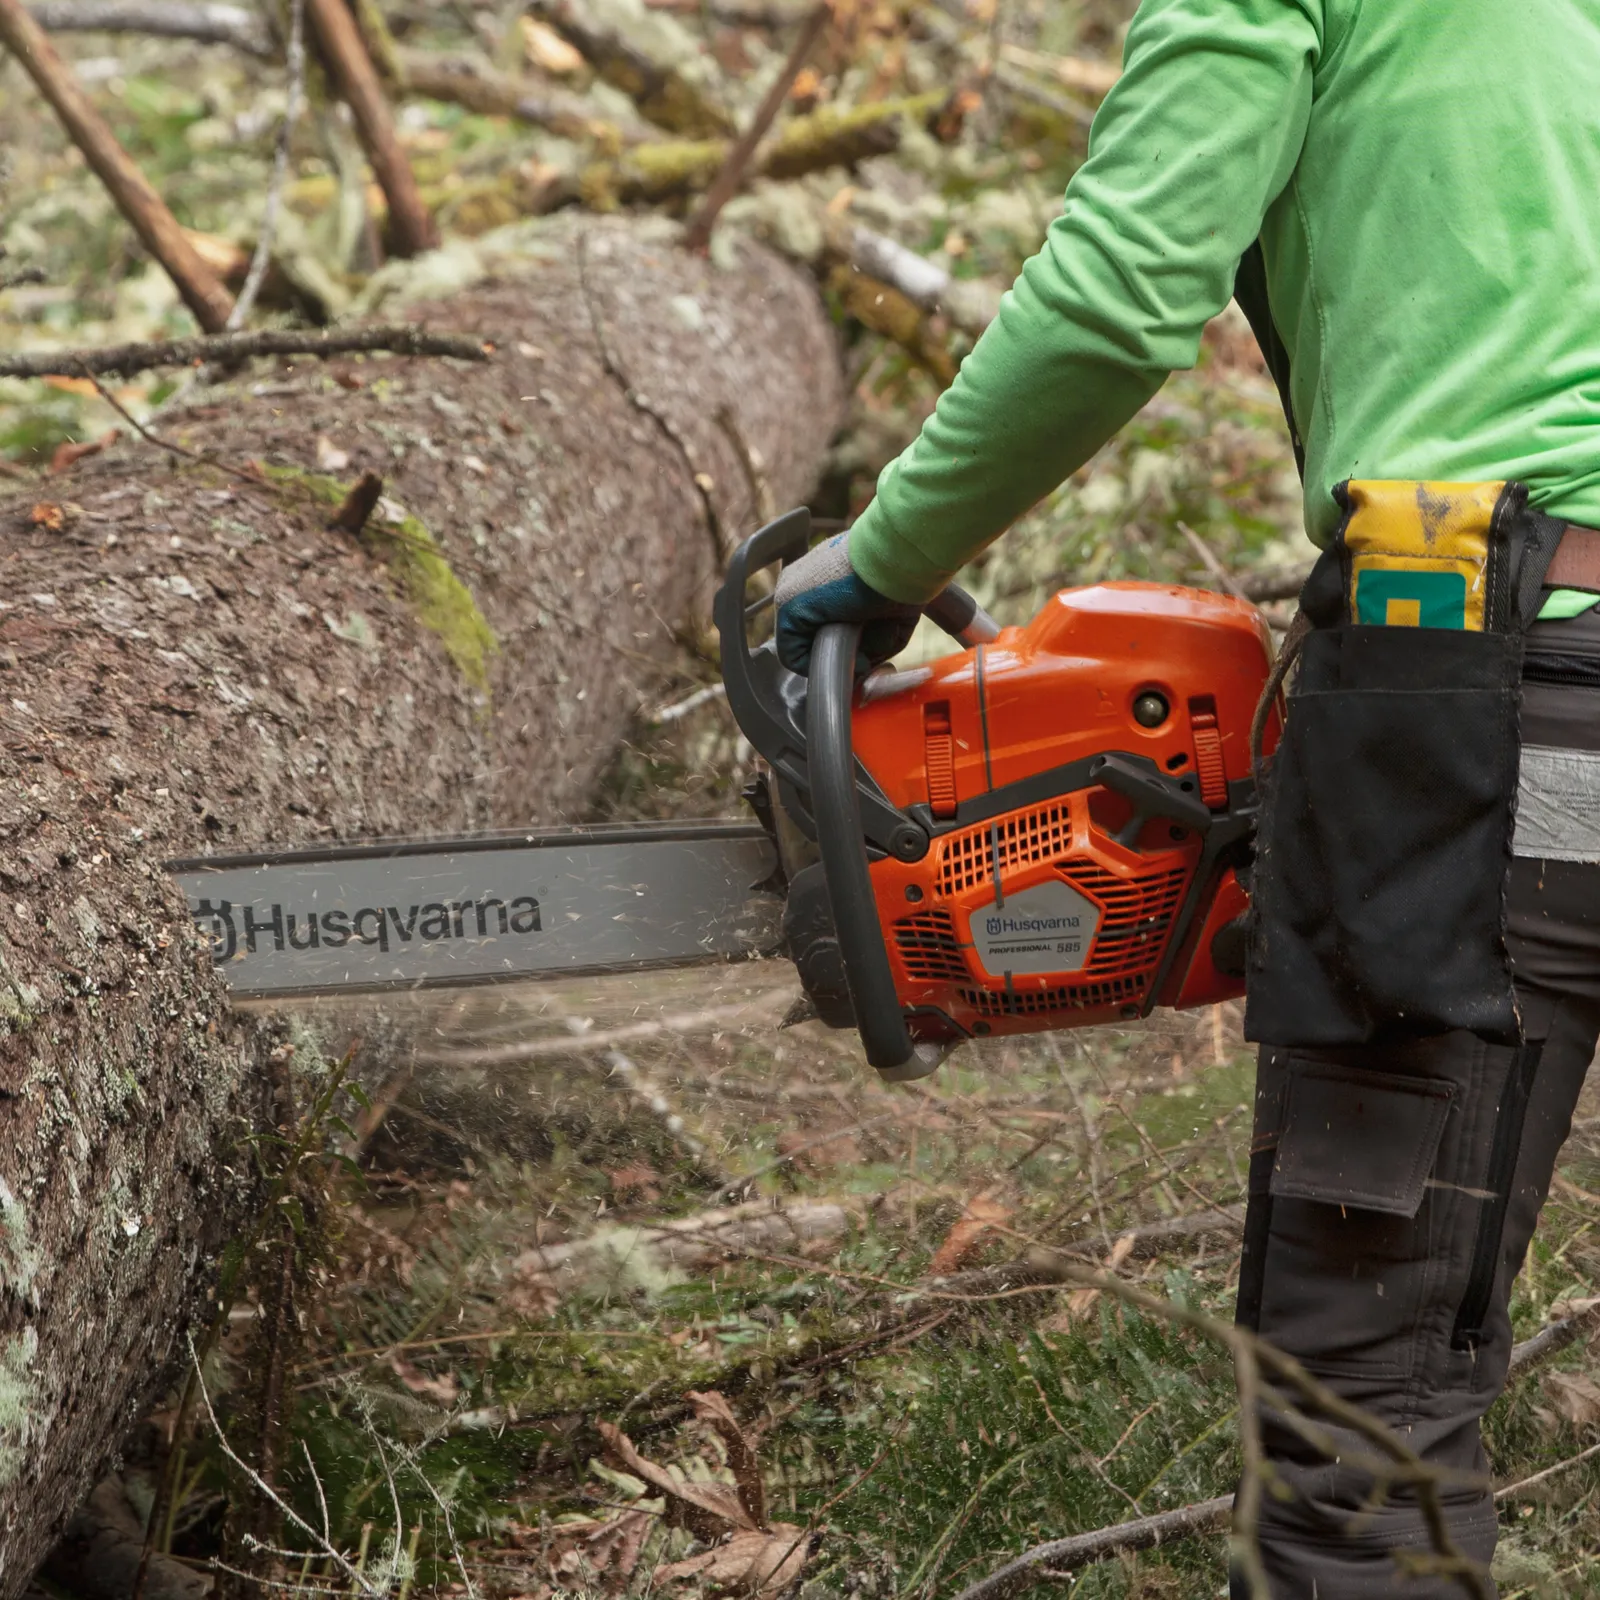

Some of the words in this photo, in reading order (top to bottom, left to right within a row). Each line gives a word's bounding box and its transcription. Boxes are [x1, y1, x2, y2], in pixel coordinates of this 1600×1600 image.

[243, 896, 542, 953] Husqvarna
[1003, 916, 1080, 932] Husqvarna
[989, 944, 1052, 955] PROFESSIONAL
[1057, 941, 1081, 953] 585
